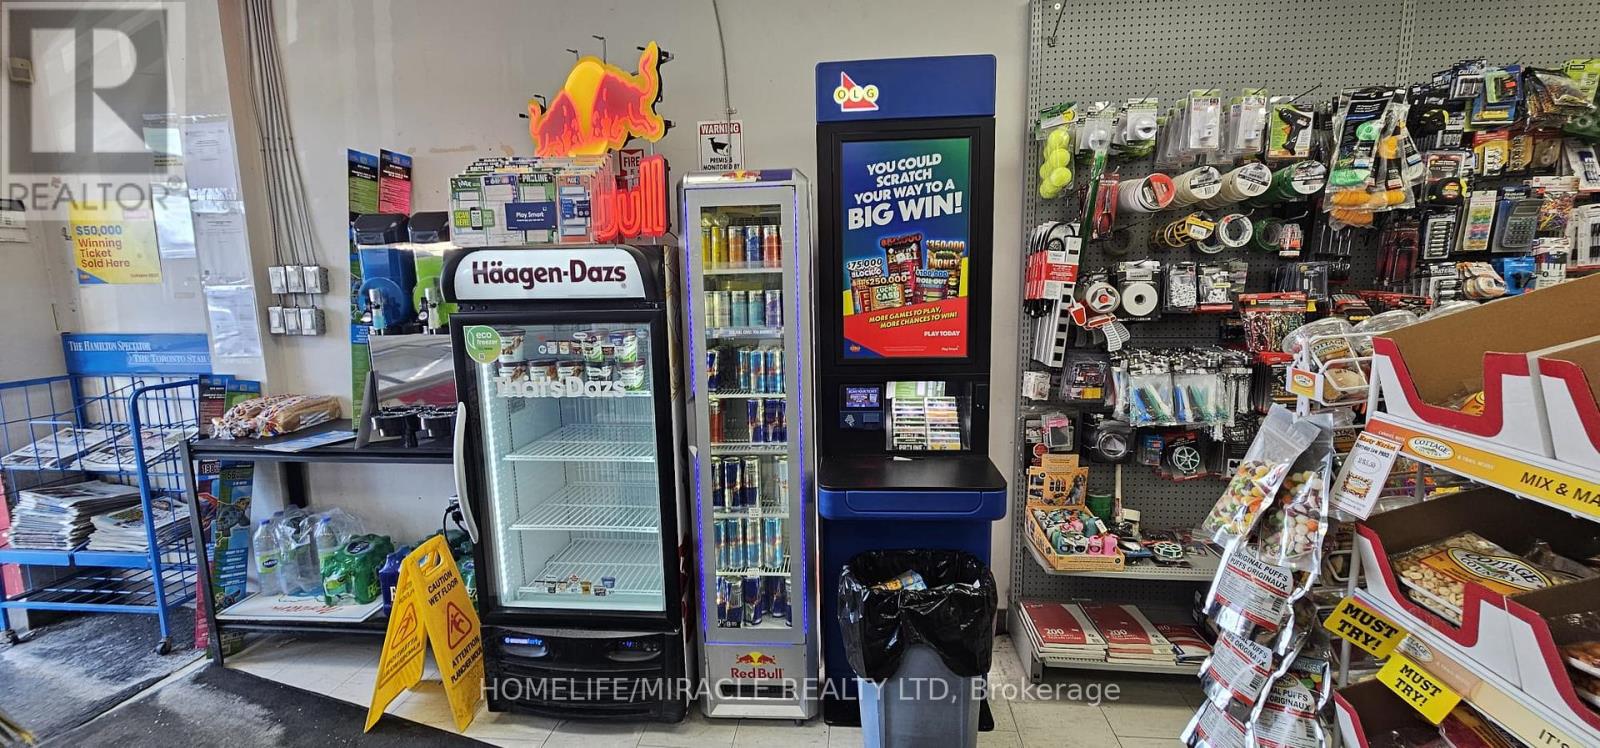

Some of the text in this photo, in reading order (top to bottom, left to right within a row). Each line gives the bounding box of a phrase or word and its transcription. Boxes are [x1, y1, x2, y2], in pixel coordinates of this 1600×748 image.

[837, 88, 875, 99] OLG
[701, 123, 739, 134] WARNING
[623, 156, 640, 167] FIRE
[866, 153, 942, 176] YOU COULD
[876, 168, 932, 188] SCRATCH
[854, 178, 955, 205] YOUR WAY TO A
[515, 210, 545, 219] Play Smart
[848, 191, 963, 230] BIG WIN!
[76, 225, 122, 237] $50,000
[78, 238, 122, 250] Winning
[80, 249, 112, 258] Ticket
[81, 259, 130, 268] Sold Here
[471, 257, 626, 290] Häagen-Dazs
[880, 321, 900, 329] MORE
[900, 315, 931, 326] CHANCES
[940, 311, 958, 319] WIN!
[890, 311, 913, 320] GAMES
[923, 306, 942, 314] PLAY,
[69, 341, 152, 351] THE HAMILTON SPECTATOR
[134, 354, 147, 363] THE
[151, 354, 185, 363] TORONTO
[1414, 438, 1449, 455] COTTAGE
[1520, 472, 1556, 491] MIX
[1555, 483, 1569, 496] &
[1231, 557, 1247, 570] PUFFS
[1246, 567, 1288, 591] ORIGINAUX
[1233, 551, 1289, 582] ORIGINAL PUFFS
[1465, 553, 1537, 583] COTTAGE
[427, 570, 453, 593] CAUTION
[428, 592, 442, 607] WET
[441, 577, 459, 597] FLOOR
[1342, 603, 1399, 639] MUST
[1338, 619, 1382, 651] TRY!
[452, 635, 480, 669] ATTENTION
[1249, 640, 1268, 659] PUFFS
[731, 667, 783, 679] Red Bull
[1400, 664, 1442, 697] MUST
[1282, 689, 1308, 701] PUFFS
[1395, 678, 1428, 707] TRY!
[1269, 696, 1311, 711] ORIGINAUX
